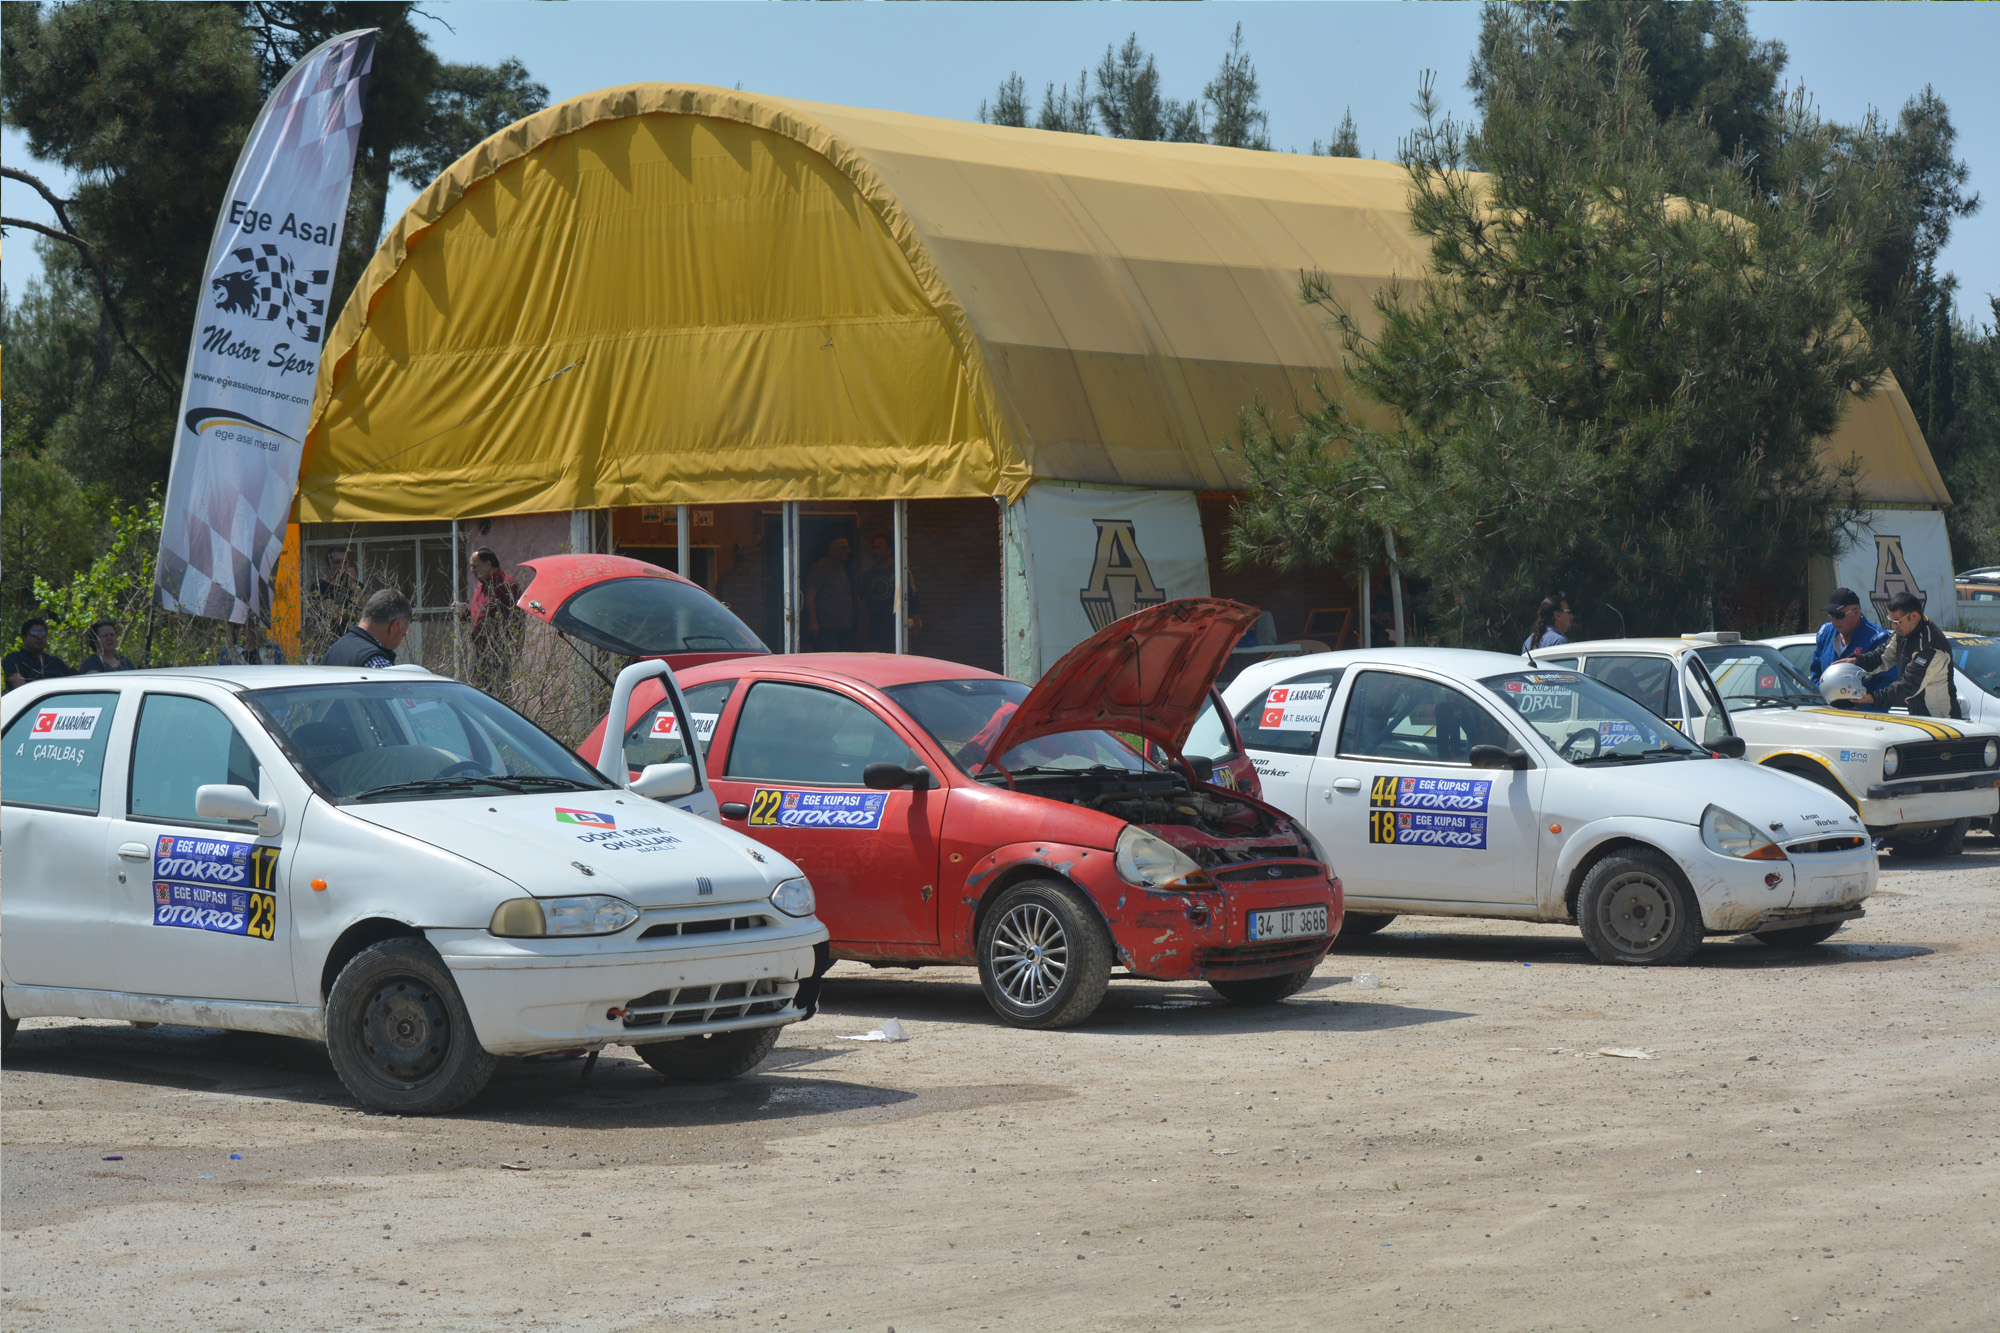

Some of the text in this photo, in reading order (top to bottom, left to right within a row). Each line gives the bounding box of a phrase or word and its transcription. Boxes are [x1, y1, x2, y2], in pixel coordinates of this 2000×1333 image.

[229, 200, 337, 247] Ege Asal
[202, 324, 316, 377] Motor Spor
[193, 371, 309, 406] www.egeasalmotorspor.com
[215, 429, 280, 453] ege asal metal
[1295, 714, 1321, 723] BAKKAL
[16, 743, 85, 767] A ÇATALBAŞ
[1250, 758, 1270, 766] eon
[1371, 776, 1398, 807] 44
[1419, 780, 1470, 792] EGE KUPASI
[750, 790, 782, 825] 22
[802, 795, 861, 806] EGE KUPASI
[1400, 793, 1485, 809] OTOKROS
[781, 809, 878, 826] OTOKROS
[1371, 811, 1396, 843] 18
[1416, 815, 1432, 825] EGE
[1434, 816, 1466, 828] KUPASI
[1814, 819, 1840, 827] Worker
[576, 826, 671, 843] DÖRT RENK
[602, 835, 682, 851] OKULLARI
[1399, 829, 1482, 846] OTOKROS
[176, 839, 195, 853] EGE
[195, 841, 230, 857] KUPASI
[157, 857, 246, 882] OTOKROS
[251, 846, 281, 889] 17
[174, 886, 191, 900] EGE
[193, 887, 227, 905] KUPASI
[158, 904, 245, 930] OTOKROS
[247, 893, 275, 940] 23
[1257, 909, 1326, 936] 34 UT 3686
